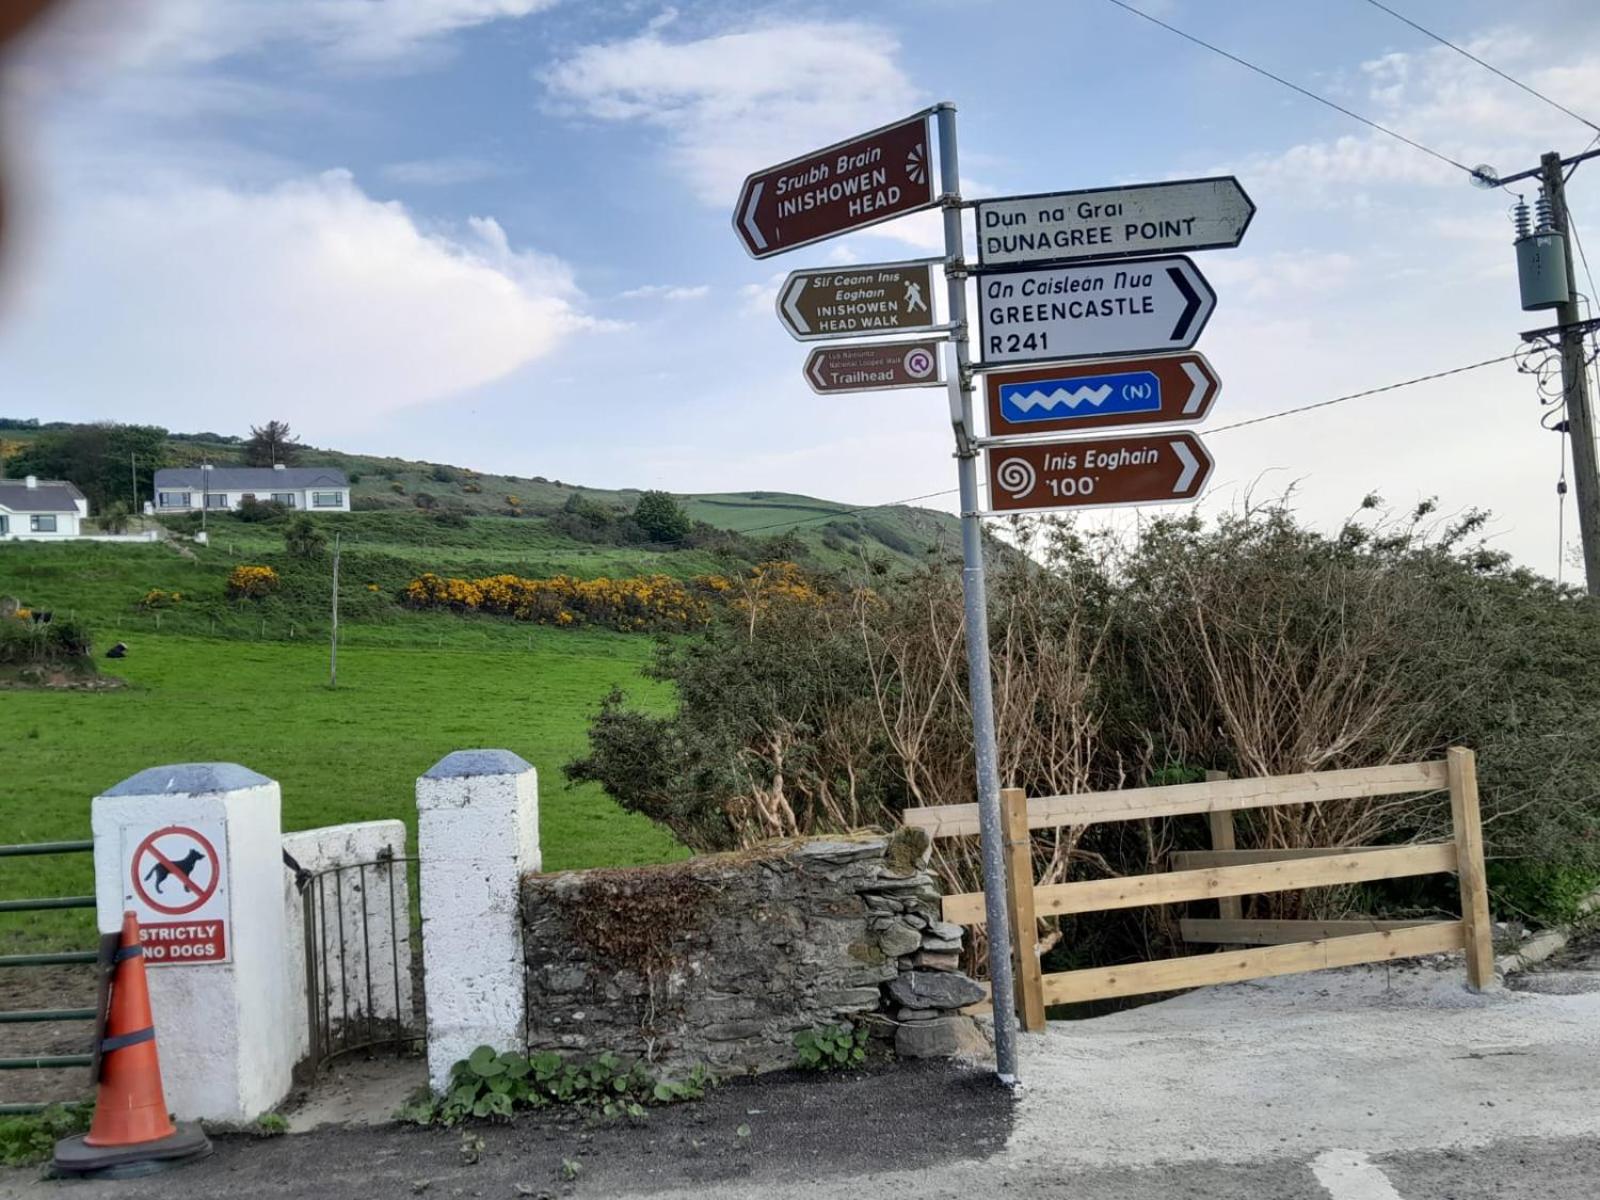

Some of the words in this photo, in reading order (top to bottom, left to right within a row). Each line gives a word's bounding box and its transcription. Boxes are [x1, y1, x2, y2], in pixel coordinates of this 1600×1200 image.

[836, 147, 881, 175] Brain
[778, 168, 886, 219] INISHOWEN
[849, 187, 900, 217] HEAD
[1039, 208, 1064, 222] na
[988, 227, 1112, 254] DUNAGREE
[1126, 217, 1196, 241] POINT
[834, 275, 873, 286] Ceann
[878, 272, 900, 282] Inis
[988, 281, 1013, 299] An
[1114, 271, 1153, 290] Nua
[835, 288, 885, 301] Eoghain
[817, 301, 898, 317] INISHOWEN
[990, 296, 1154, 325] GREENCASTLE
[819, 318, 856, 331] HEAD
[861, 315, 899, 328] WALK
[830, 369, 894, 385] Trailhead
[1122, 383, 1152, 401] (N)
[1044, 453, 1077, 472] Inis
[1084, 447, 1159, 472] Eoghain
[139, 925, 216, 941] STRICTLY
[142, 946, 165, 959] NO
[170, 943, 216, 957] DOGS
